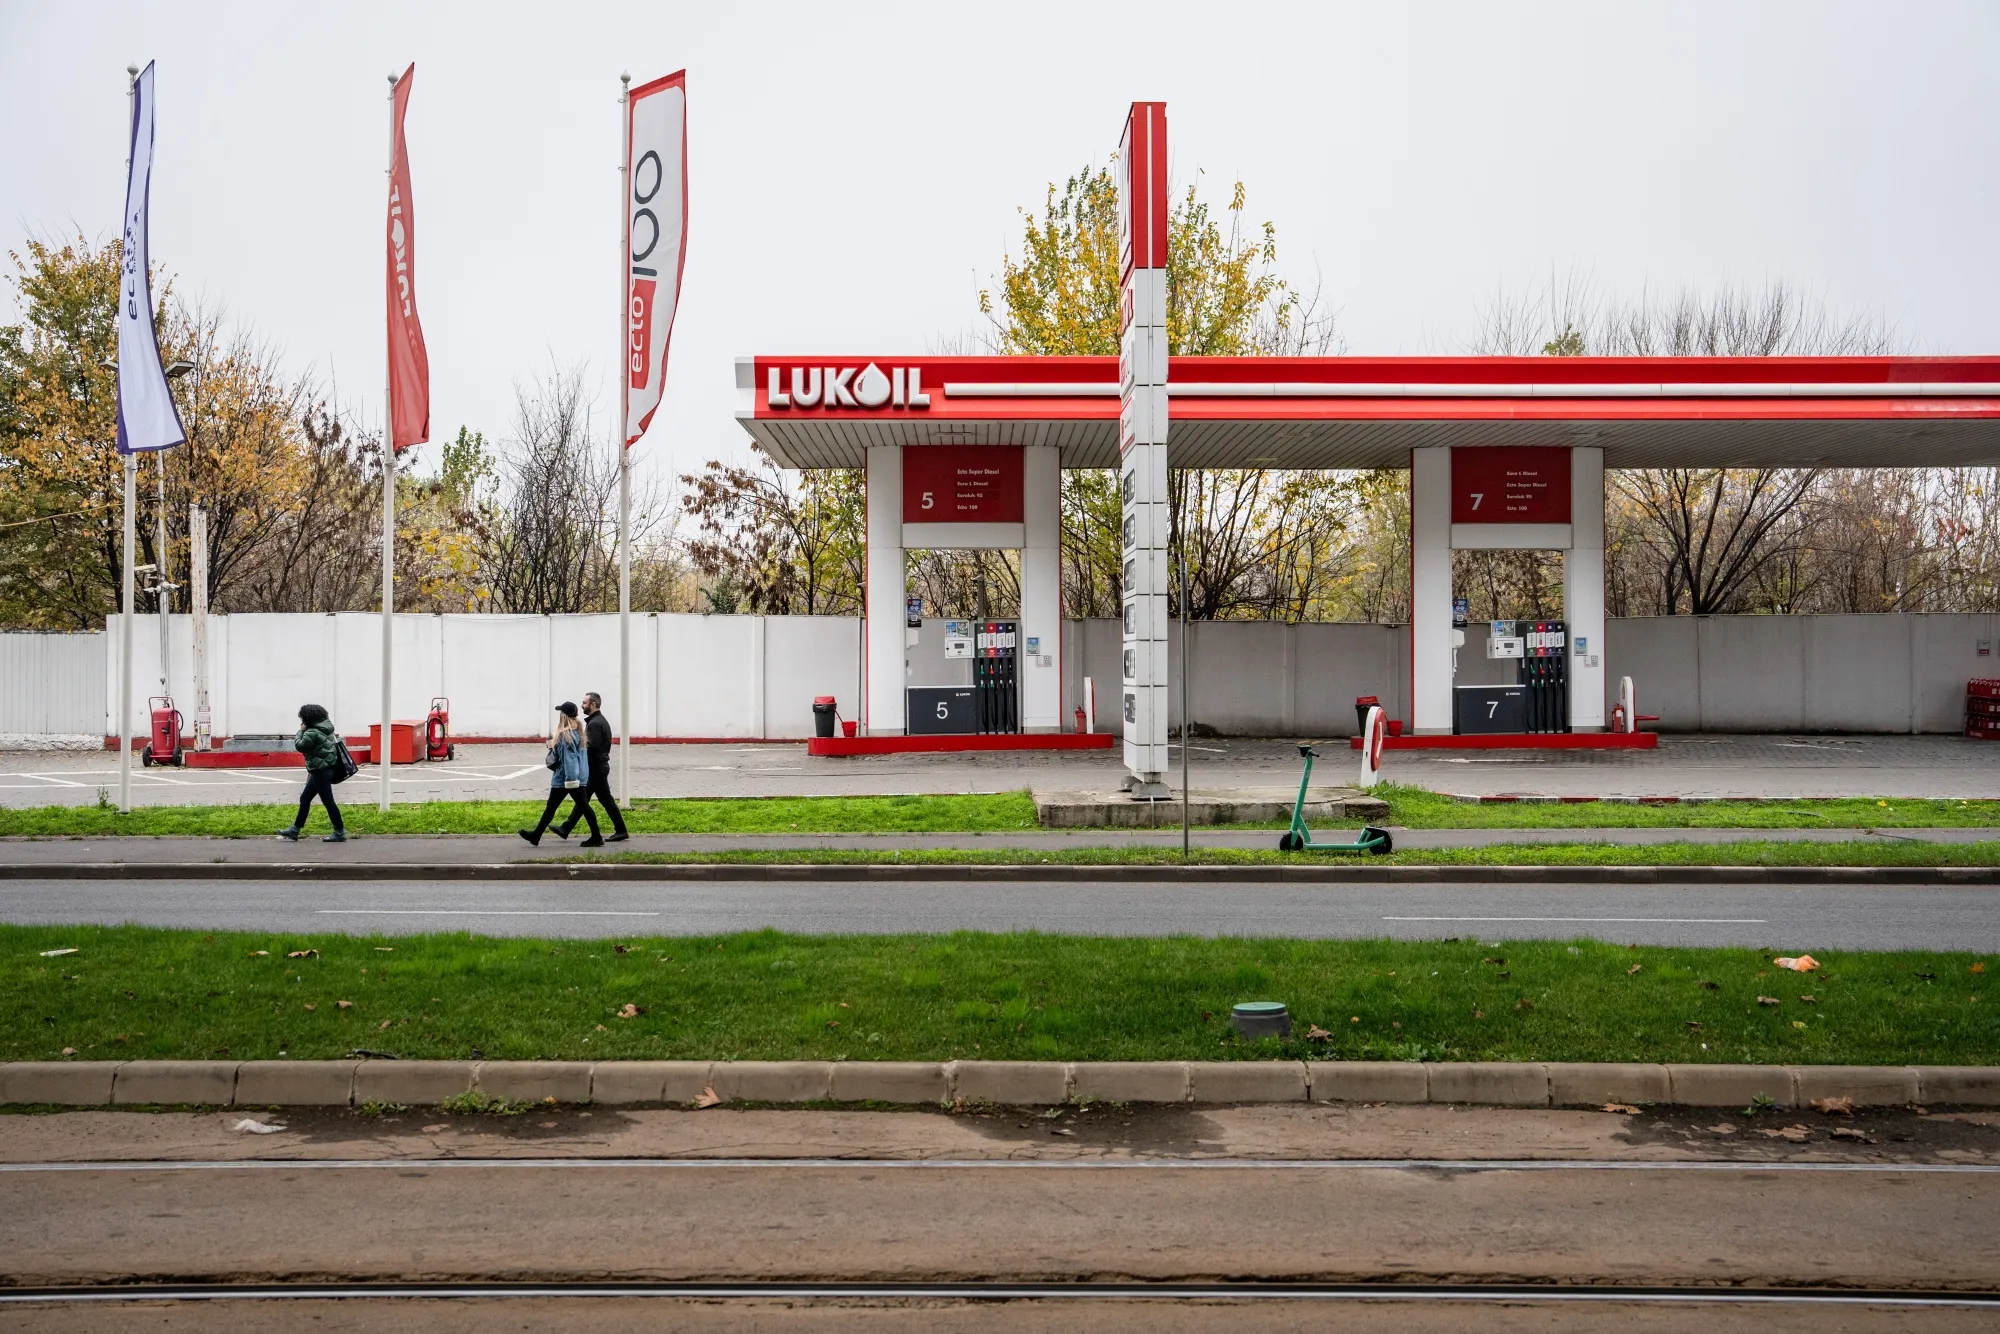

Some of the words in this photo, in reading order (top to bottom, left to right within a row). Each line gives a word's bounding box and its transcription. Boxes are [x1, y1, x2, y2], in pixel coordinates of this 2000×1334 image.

[768, 362, 931, 407] LUKOIL
[969, 468, 983, 476] Super
[921, 491, 935, 510] 5
[1470, 493, 1484, 511] 7
[936, 701, 949, 720] 5
[1486, 701, 1499, 719] 7
